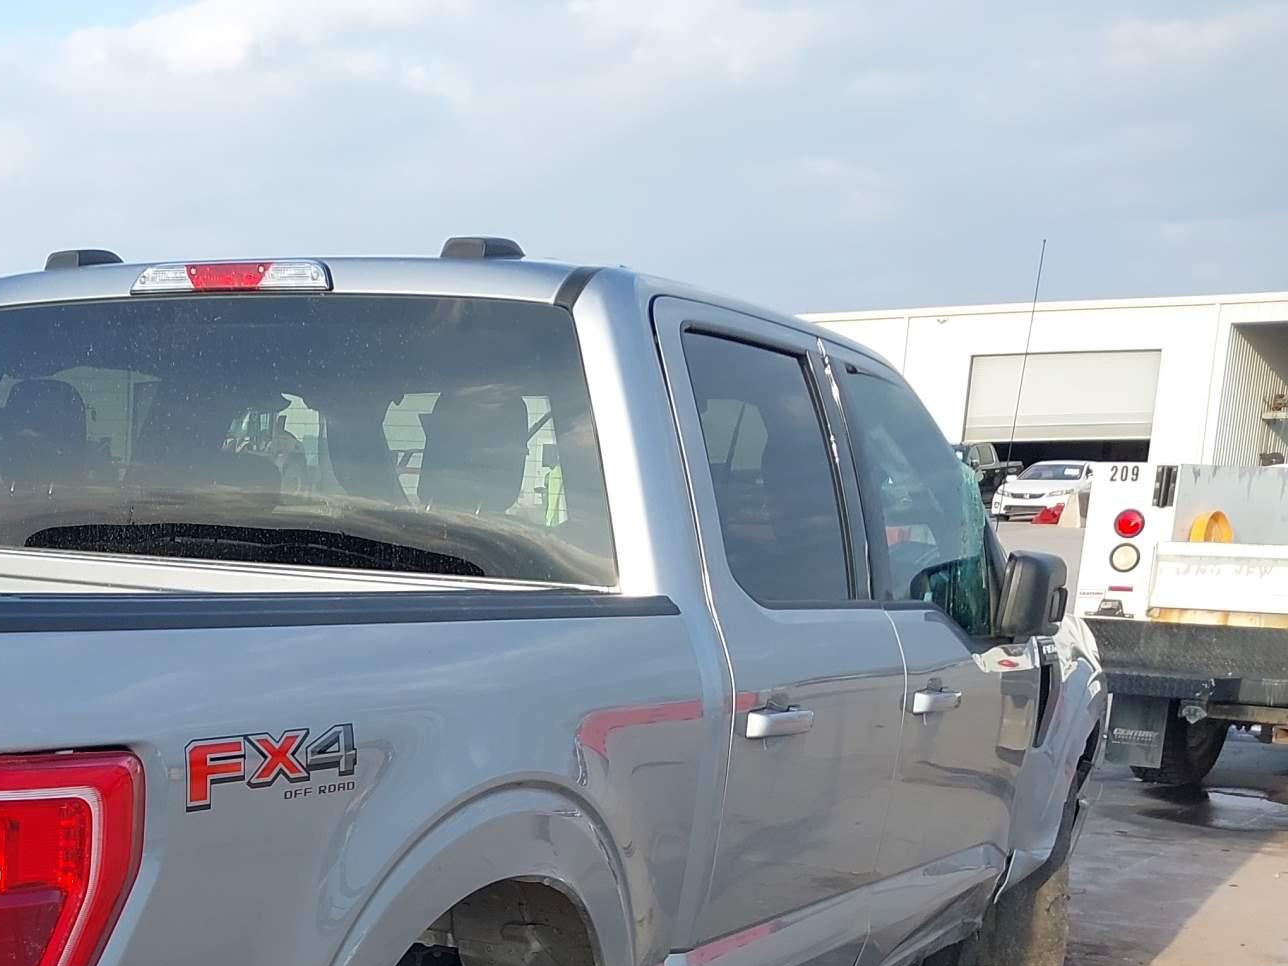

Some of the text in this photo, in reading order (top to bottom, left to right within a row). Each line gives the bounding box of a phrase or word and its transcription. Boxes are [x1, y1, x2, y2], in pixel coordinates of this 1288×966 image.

[1110, 465, 1140, 482] 209
[185, 723, 357, 812] FX4
[283, 781, 355, 800] OFF ROAD
